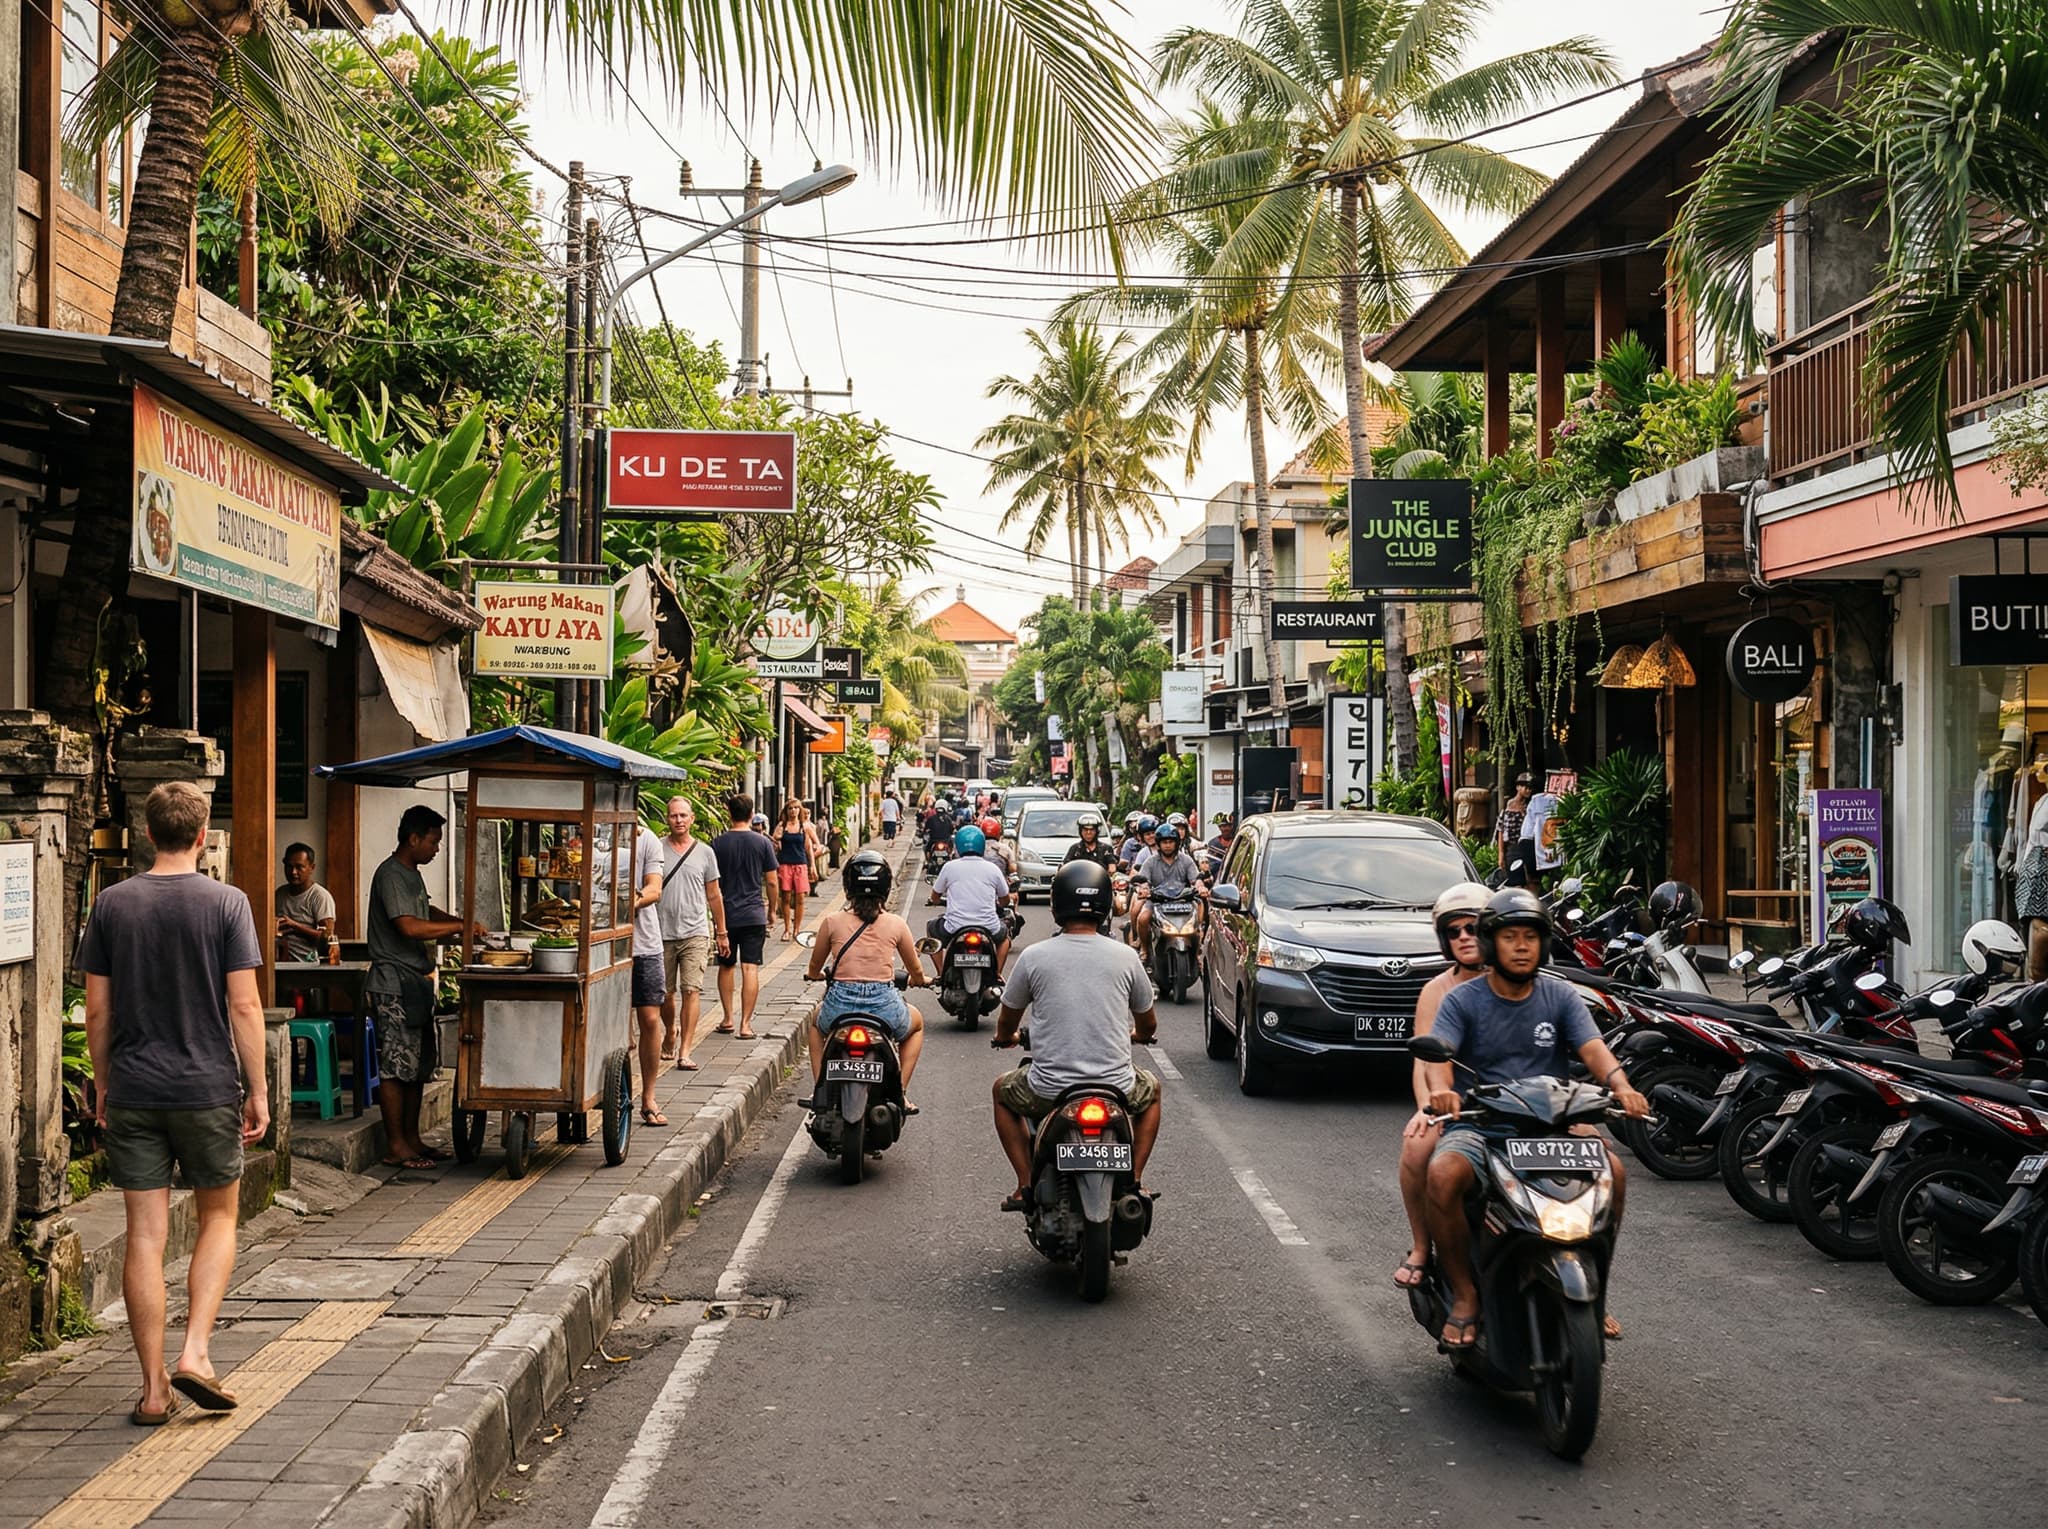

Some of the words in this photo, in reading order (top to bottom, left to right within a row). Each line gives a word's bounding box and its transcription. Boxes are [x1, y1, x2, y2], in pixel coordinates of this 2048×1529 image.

[159, 409, 227, 489] WARUNG
[229, 445, 275, 511] MAKAN
[278, 470, 310, 525] KAYU
[312, 489, 332, 537] AYA
[619, 455, 666, 477] KU
[680, 457, 727, 479] DE
[739, 458, 783, 480] TA
[1392, 500, 1430, 516] THE
[1362, 519, 1460, 539] JUNGLE
[1385, 542, 1437, 558] CLUB
[483, 594, 548, 611] Warung
[551, 592, 604, 616] Makan
[485, 616, 551, 639] KAYU
[555, 619, 602, 641] AYA
[1276, 613, 1376, 628] RESTAURANT
[1744, 643, 1803, 668] BALI
[1357, 1017, 1373, 1031] DK
[1059, 1146, 1074, 1158] DK
[1113, 1146, 1128, 1159] BF
[1510, 1141, 1533, 1156] DK
[1537, 1142, 1576, 1157] 8712
[1581, 1142, 1599, 1157] AY
